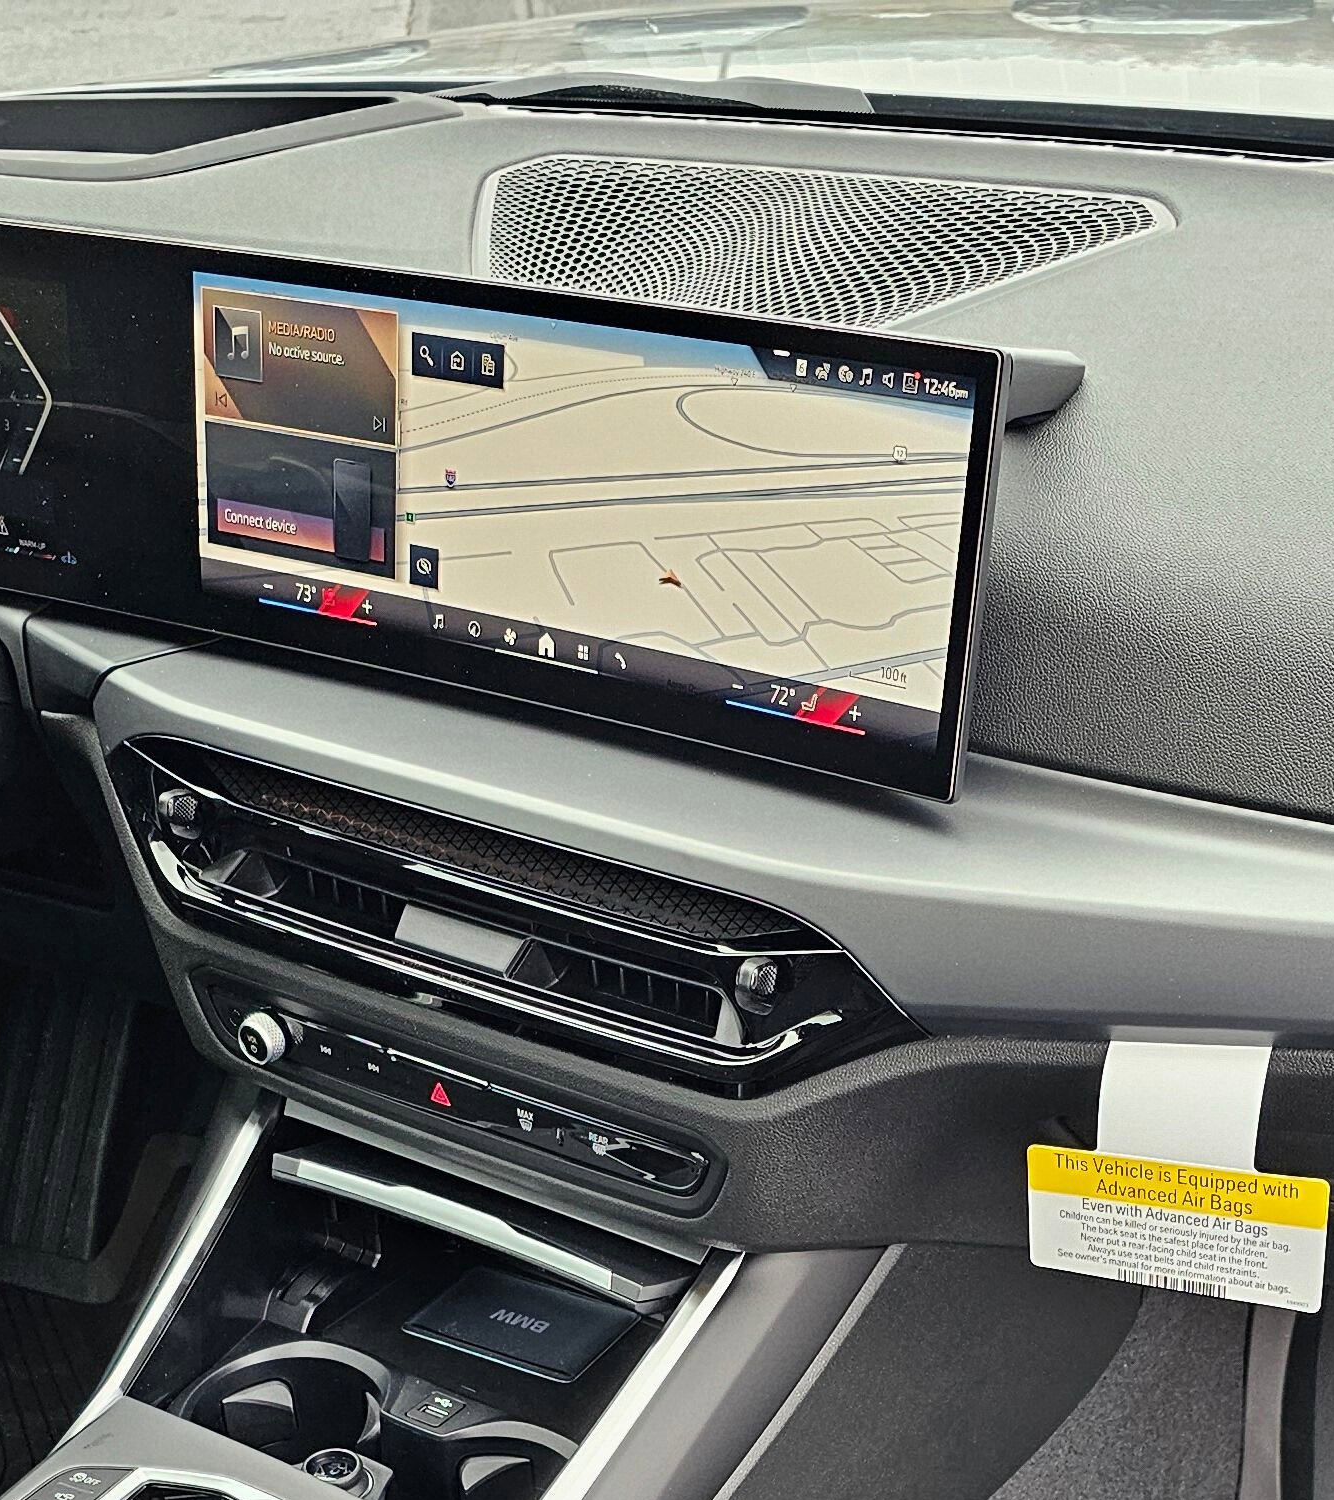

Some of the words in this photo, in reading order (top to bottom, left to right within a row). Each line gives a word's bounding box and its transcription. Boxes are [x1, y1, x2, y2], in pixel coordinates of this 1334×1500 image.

[268, 320, 335, 343] MEDIA/RADIO
[268, 342, 282, 356] No
[283, 345, 309, 362] active
[311, 350, 345, 366] source.
[4, 419, 10, 431] 3
[224, 508, 265, 529] Connect
[266, 515, 297, 536] device
[18, 538, 46, 551] WARM-UP
[880, 666, 899, 682] 100
[900, 671, 907, 684] ft
[517, 1108, 534, 1121] MAX
[588, 1131, 609, 1145] REAR
[1054, 1153, 1088, 1171] This
[1093, 1158, 1153, 1180] Vehicle
[1159, 1166, 1171, 1183] is
[1177, 1169, 1258, 1194] Equipped
[1263, 1181, 1299, 1199] with
[1096, 1179, 1177, 1204] Advanced
[1182, 1191, 1205, 1208] Air
[1210, 1194, 1253, 1217] Bags
[1060, 1209, 1094, 1223] Children
[1096, 1216, 1110, 1225] can
[1113, 1218, 1123, 1227] be
[1125, 1219, 1147, 1231] killed
[1159, 1226, 1197, 1239] seriously
[1199, 1230, 1227, 1242] injured
[1231, 1235, 1241, 1246] by
[1243, 1237, 1257, 1247] the
[1259, 1240, 1270, 1249] air
[1272, 1241, 1291, 1253] bag.
[1082, 1198, 1112, 1213] Even
[1116, 1203, 1142, 1218] with
[1146, 1207, 1209, 1228] Advanced
[1212, 1217, 1231, 1231] Air
[1235, 1220, 1269, 1238] Bags
[1080, 1232, 1104, 1244] Never
[1107, 1238, 1119, 1247] put
[1129, 1241, 1174, 1257] rear-facing
[1176, 1248, 1196, 1259] child
[1199, 1252, 1216, 1262] seat
[1218, 1255, 1226, 1263] in
[1229, 1255, 1242, 1266] the
[1244, 1258, 1267, 1270] front.
[1081, 1223, 1096, 1233] The
[1098, 1225, 1117, 1236] back
[1120, 1230, 1138, 1239] seat
[1140, 1232, 1146, 1241] is
[1148, 1233, 1162, 1243] the
[1164, 1236, 1189, 1248] safest
[1191, 1240, 1214, 1251] place
[1217, 1243, 1228, 1252] for
[1230, 1246, 1267, 1259] children.
[1057, 1248, 1073, 1258] See
[1075, 1253, 1107, 1264] owner's
[1109, 1258, 1139, 1270] manual
[1141, 1262, 1152, 1271] for
[1154, 1266, 1176, 1275] more
[1177, 1270, 1226, 1284] information
[1228, 1278, 1253, 1289] about
[1255, 1281, 1265, 1290] air
[1267, 1282, 1291, 1294] bags.
[1088, 1244, 1116, 1256] Always
[1118, 1250, 1132, 1259] use
[1135, 1252, 1152, 1261] seat
[1154, 1254, 1174, 1266] belts
[1176, 1259, 1192, 1269] and
[1194, 1261, 1214, 1271] child
[1217, 1266, 1260, 1279] restraints.
[489, 1309, 551, 1334] BMW
[84, 1477, 102, 1486] OFF
